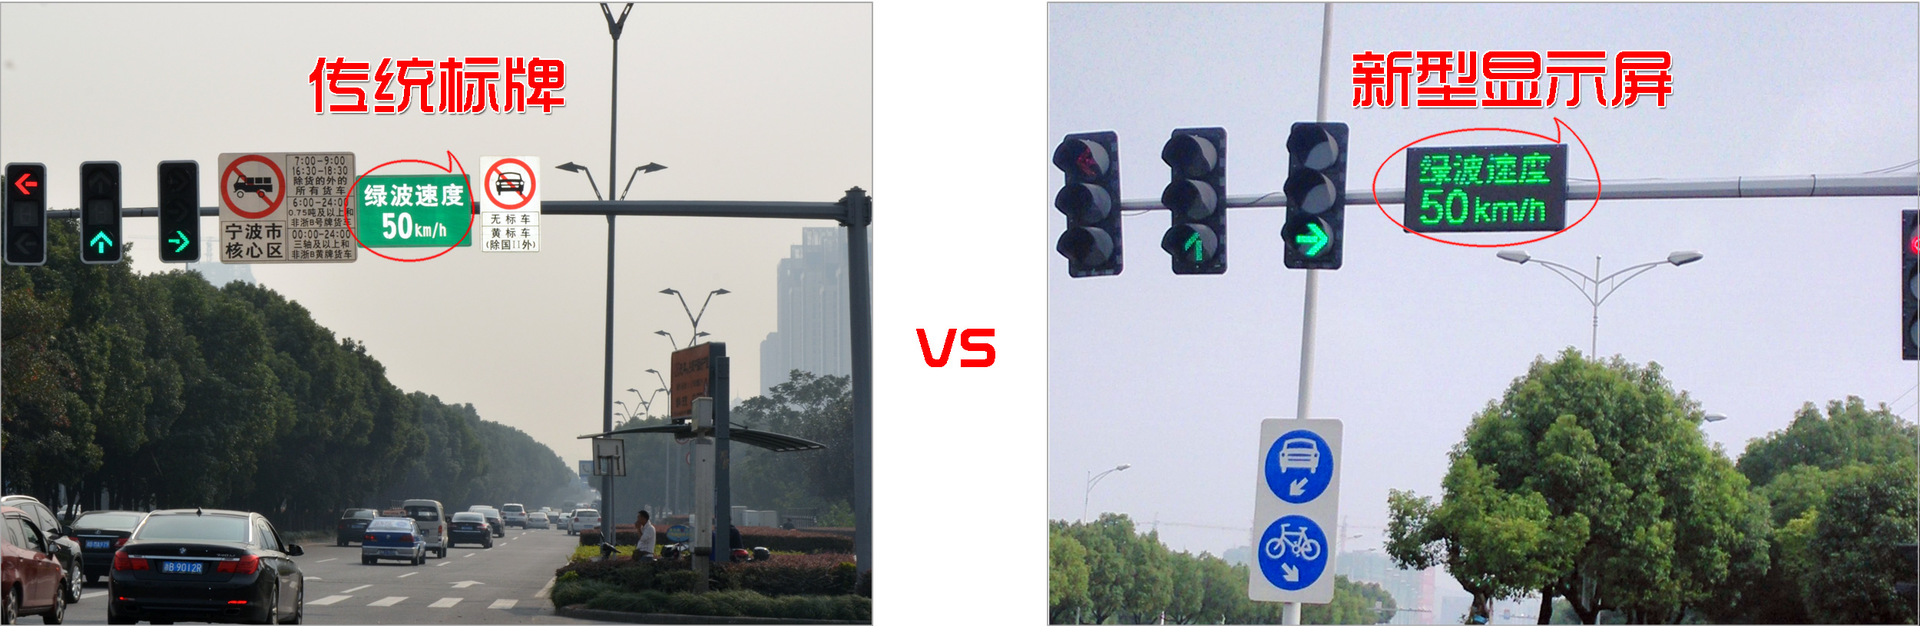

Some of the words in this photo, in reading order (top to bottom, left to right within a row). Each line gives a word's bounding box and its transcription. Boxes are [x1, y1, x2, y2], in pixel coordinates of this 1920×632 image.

[294, 156, 346, 165] 7:00-9:00
[292, 166, 348, 176] 16:30-18:30
[1419, 152, 1552, 186] 绿波速度
[295, 186, 346, 196] 所有货车
[364, 183, 464, 207] 绿波速度
[1419, 188, 1469, 225] 50
[1474, 196, 1546, 223] km/h
[490, 214, 531, 225] 无标车
[382, 212, 413, 239] 50
[415, 222, 447, 239] km/h
[225, 223, 283, 240] 宁波市
[292, 229, 351, 239] 00:00-24:00
[490, 227, 531, 238] 黄标车
[294, 240, 350, 249] 三轴及以上和
[225, 242, 283, 259] 核心区
